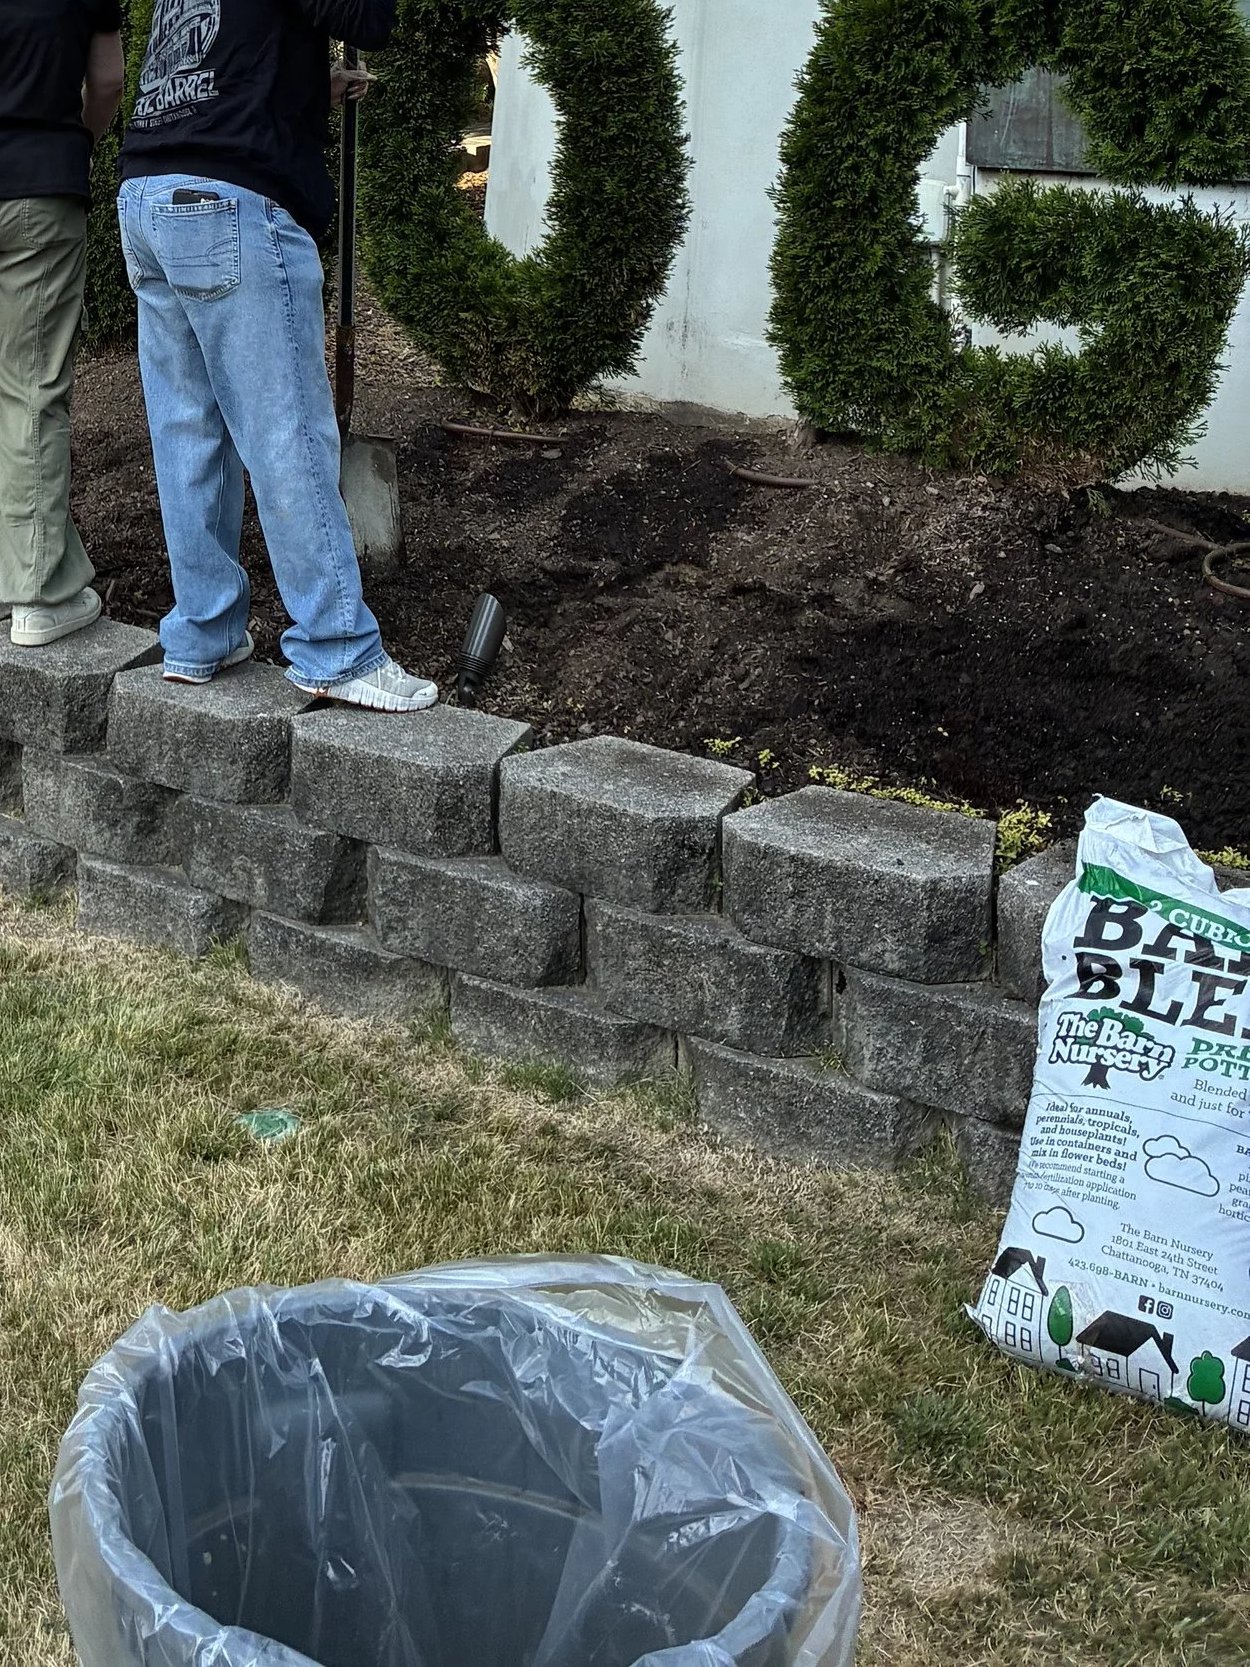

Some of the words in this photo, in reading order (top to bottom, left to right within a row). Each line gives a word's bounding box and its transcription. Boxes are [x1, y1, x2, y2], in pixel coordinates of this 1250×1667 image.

[1058, 1012, 1099, 1037] The
[1096, 1018, 1173, 1063] Barn
[1050, 1038, 1172, 1081] Nursery
[1193, 1079, 1248, 1101] Blended
[1046, 1101, 1069, 1112] Ideal
[1069, 1102, 1084, 1113] for
[1085, 1107, 1132, 1124] annuals,
[1170, 1092, 1196, 1107] and
[1198, 1099, 1223, 1111] just
[1226, 1102, 1246, 1119] for
[1036, 1114, 1086, 1126] perennials,
[1088, 1118, 1140, 1138] tropicals,
[1040, 1124, 1058, 1134] and
[1059, 1124, 1127, 1146] houseplants!
[1030, 1136, 1044, 1146] Use
[1045, 1136, 1055, 1146] in
[1056, 1138, 1112, 1155] containers
[1114, 1149, 1137, 1162] and
[1031, 1147, 1047, 1157] mix
[1049, 1148, 1059, 1157] in
[1060, 1147, 1094, 1163] flower
[1096, 1154, 1127, 1171] beds!
[1084, 1167, 1118, 1184] starting
[1118, 1176, 1125, 1184] a
[1061, 1187, 1081, 1199] after
[1086, 1181, 1137, 1201] application
[1120, 1222, 1141, 1237] The
[1143, 1229, 1168, 1246] Barn
[1170, 1238, 1214, 1262] Nursery
[1111, 1235, 1133, 1249] 1801
[1136, 1241, 1159, 1257] East
[1160, 1250, 1184, 1265] 24th
[1186, 1257, 1219, 1275] Street
[1068, 1257, 1149, 1287] 423.698-BARN
[1101, 1244, 1170, 1275] Chattanooga,
[1172, 1266, 1190, 1280] TN
[1191, 1274, 1224, 1293] 37404
